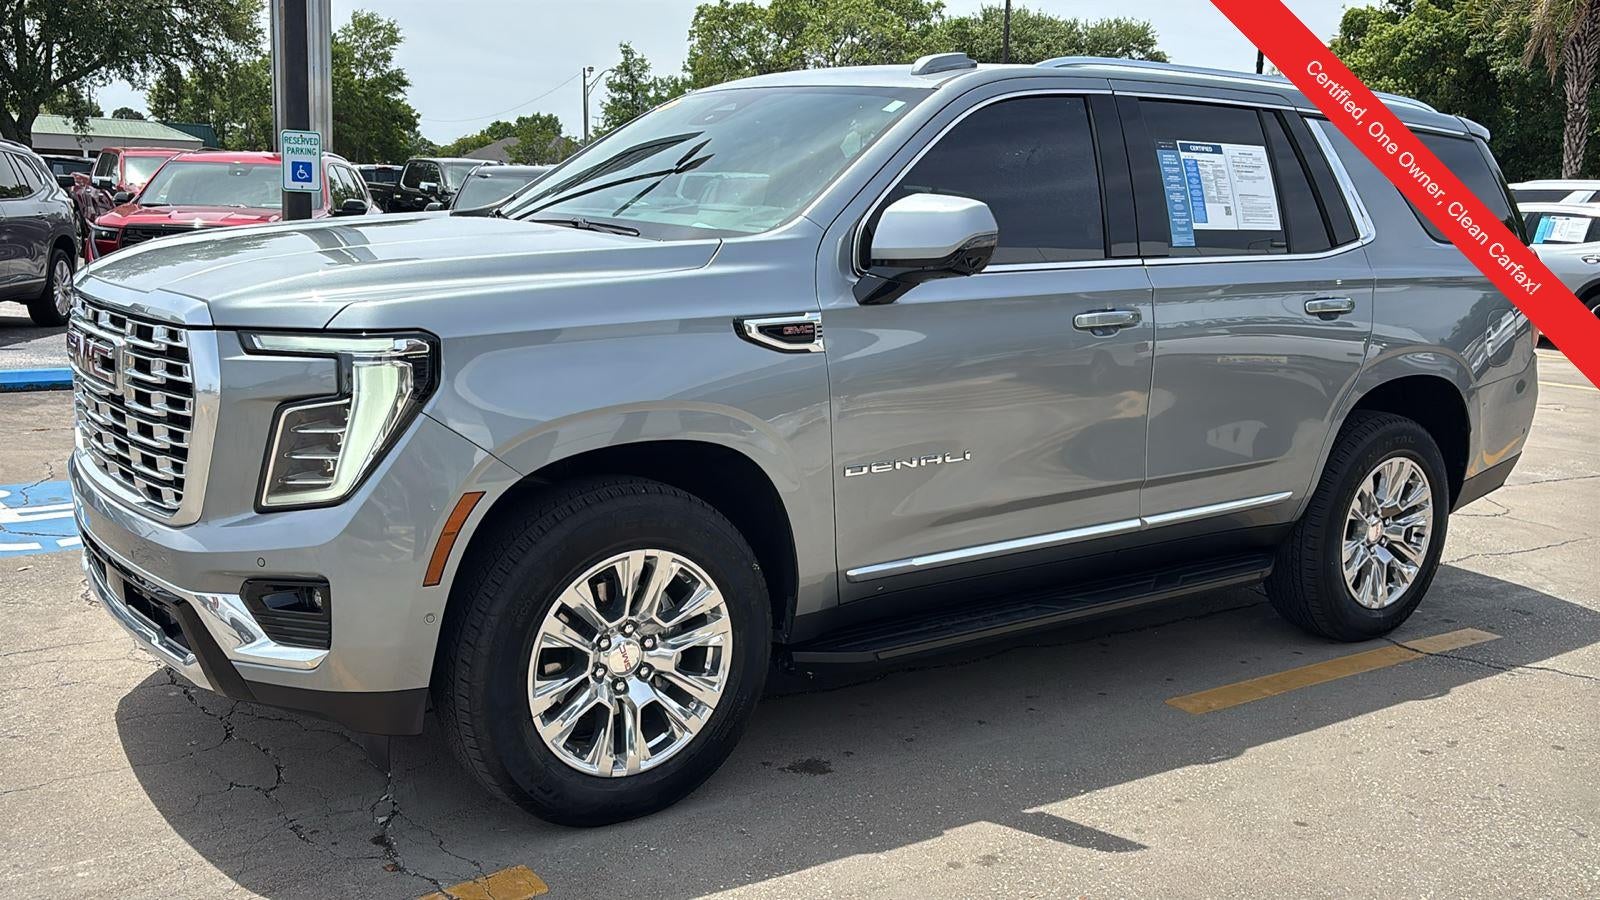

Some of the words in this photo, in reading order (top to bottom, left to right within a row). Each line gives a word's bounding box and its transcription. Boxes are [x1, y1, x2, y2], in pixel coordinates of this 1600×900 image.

[284, 136, 319, 146] RESERVED
[286, 147, 317, 156] PARKING
[1189, 145, 1213, 153] CERTIFIED
[783, 325, 814, 335] GMC
[844, 450, 971, 477] DENALI
[619, 644, 632, 672] GMC
